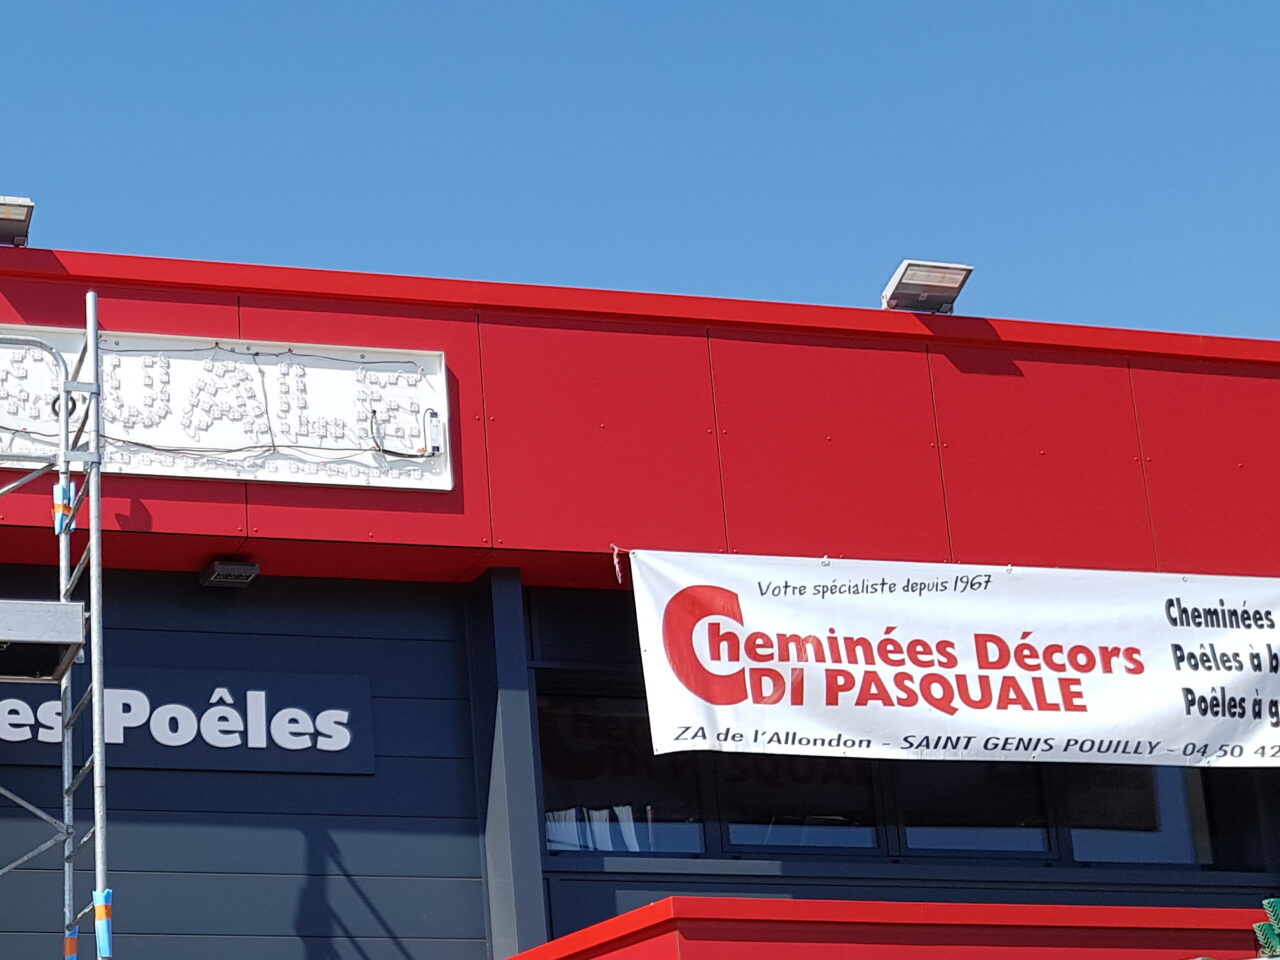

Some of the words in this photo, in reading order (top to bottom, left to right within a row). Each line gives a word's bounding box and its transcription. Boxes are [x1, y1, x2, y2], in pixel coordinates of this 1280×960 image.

[757, 580, 807, 598] Votre
[812, 578, 896, 599] spécialiste
[902, 577, 948, 597] depuis
[953, 574, 994, 593] 1967
[1165, 597, 1276, 630] Cheminées
[662, 584, 959, 706] Cheminées
[973, 631, 1146, 676] Décors
[1171, 643, 1244, 672] Poêles
[1248, 643, 1263, 673] à
[749, 667, 805, 706] DI
[825, 667, 1088, 717] PASQUALE
[1181, 686, 1247, 719] Poêles
[1251, 688, 1263, 721] à
[103, 686, 352, 752] Poêles
[673, 726, 708, 742] ZA
[716, 727, 744, 743] de
[753, 730, 872, 750] l'Allondon
[900, 734, 977, 751] SAINT
[983, 736, 1056, 753] GENIS
[1063, 738, 1162, 756] POUILLY
[1182, 742, 1209, 758] 04
[1215, 744, 1245, 758] 50
[1253, 745, 1280, 758] 42
